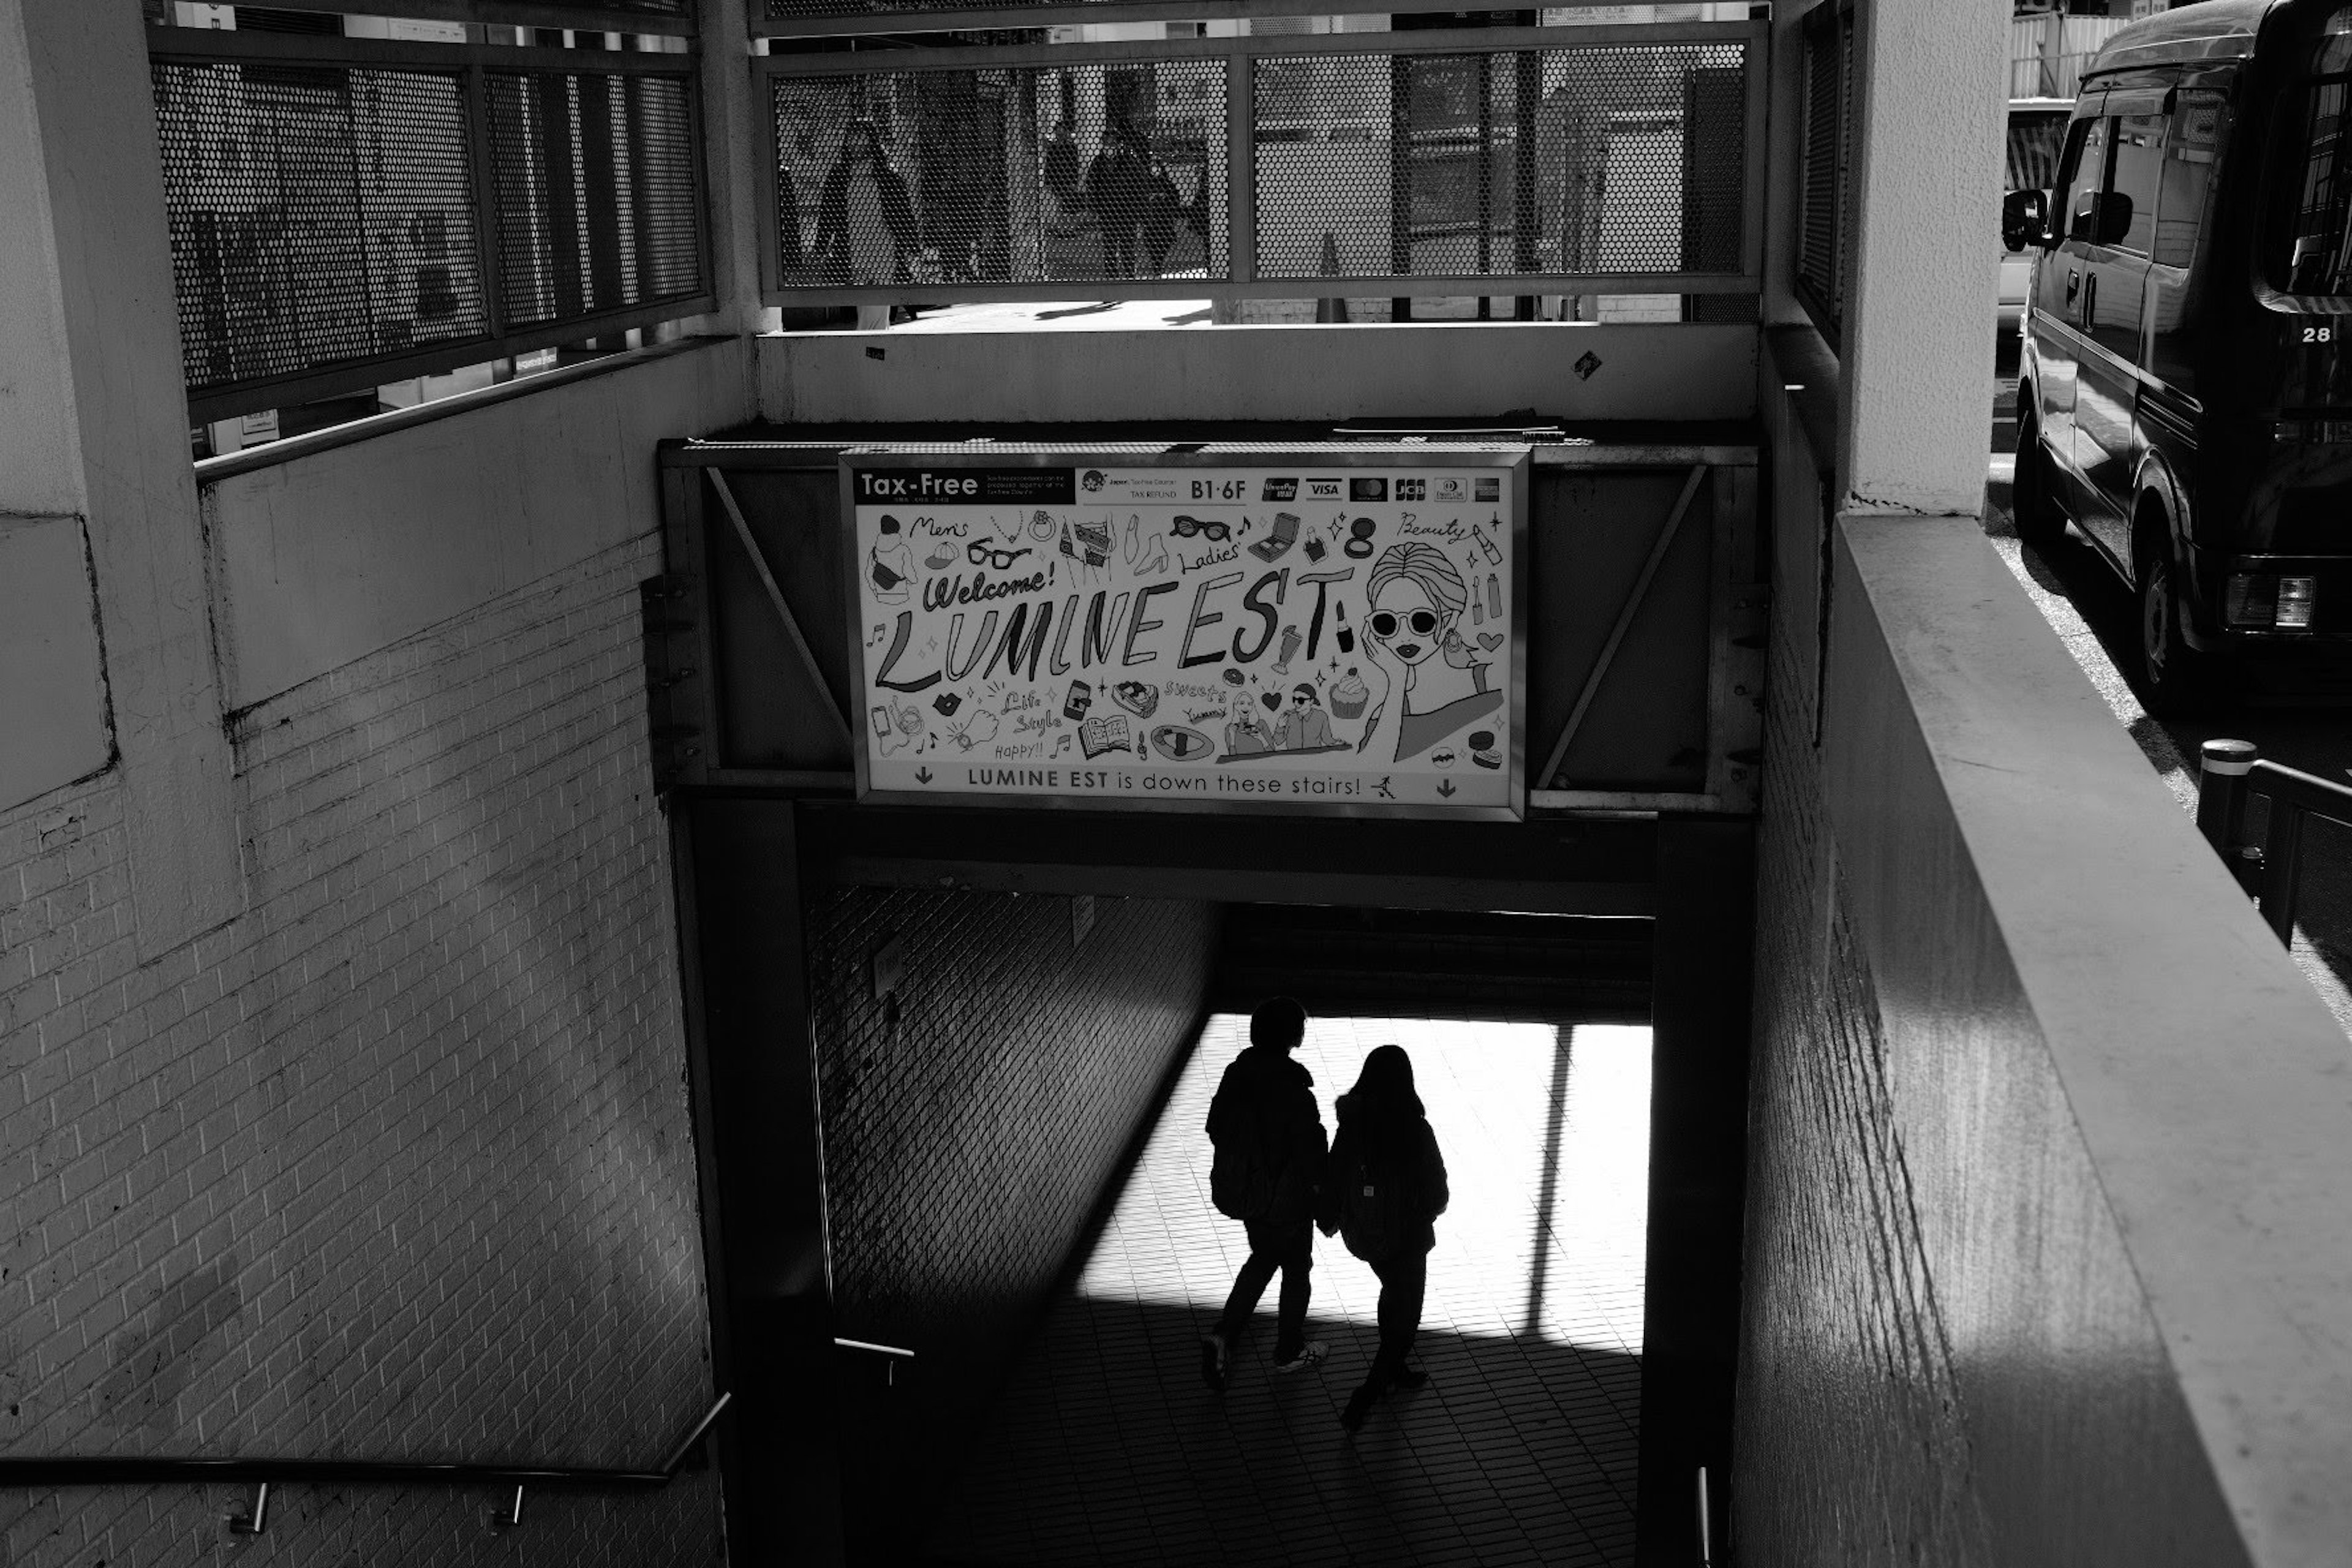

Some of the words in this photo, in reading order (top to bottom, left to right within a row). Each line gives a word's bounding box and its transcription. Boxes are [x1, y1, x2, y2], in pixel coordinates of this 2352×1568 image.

[2302, 326, 2331, 343] 28
[861, 473, 979, 495] Tax-Free
[1311, 484, 1339, 494] VISA
[910, 516, 968, 538] Men's
[1396, 511, 1468, 545] Beauty
[922, 561, 1055, 612] Welcome!
[875, 581, 1179, 692] LUMINE
[1177, 567, 1355, 669] EST
[1001, 690, 1041, 715] Life
[1164, 680, 1227, 704] Sweets
[1013, 710, 1063, 738] Style
[968, 769, 1058, 787] LUMINE
[1070, 771, 1108, 788] EST
[1118, 772, 1133, 789] is
[1143, 773, 1207, 791] down
[1218, 775, 1281, 793] these
[1292, 777, 1360, 795] stairs!
